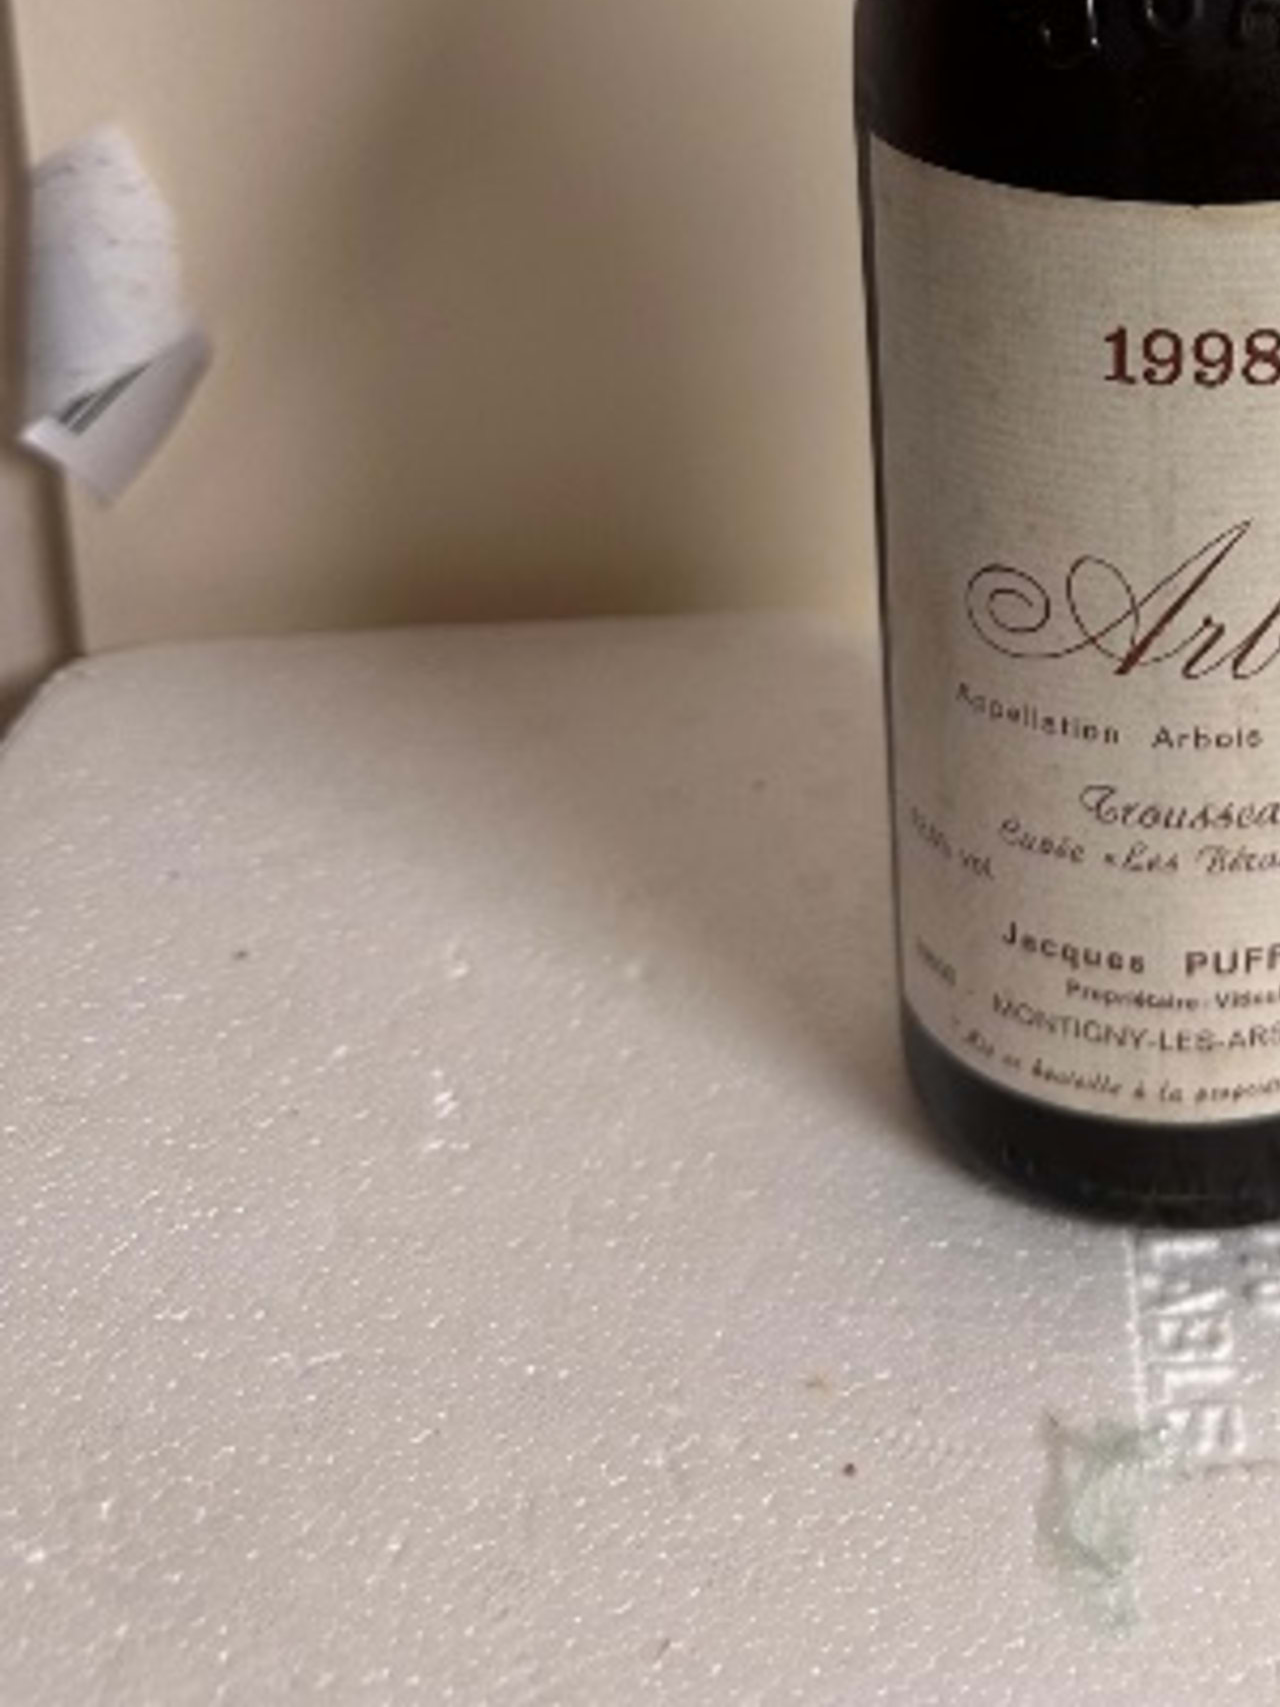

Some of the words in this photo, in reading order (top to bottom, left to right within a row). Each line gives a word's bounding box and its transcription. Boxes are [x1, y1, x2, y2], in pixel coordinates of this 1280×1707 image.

[956, 682, 1120, 744] Appellation
[1151, 725, 1264, 749] Arbois
[999, 818, 1085, 864] Cuvée
[1002, 920, 1145, 974] Jacques
